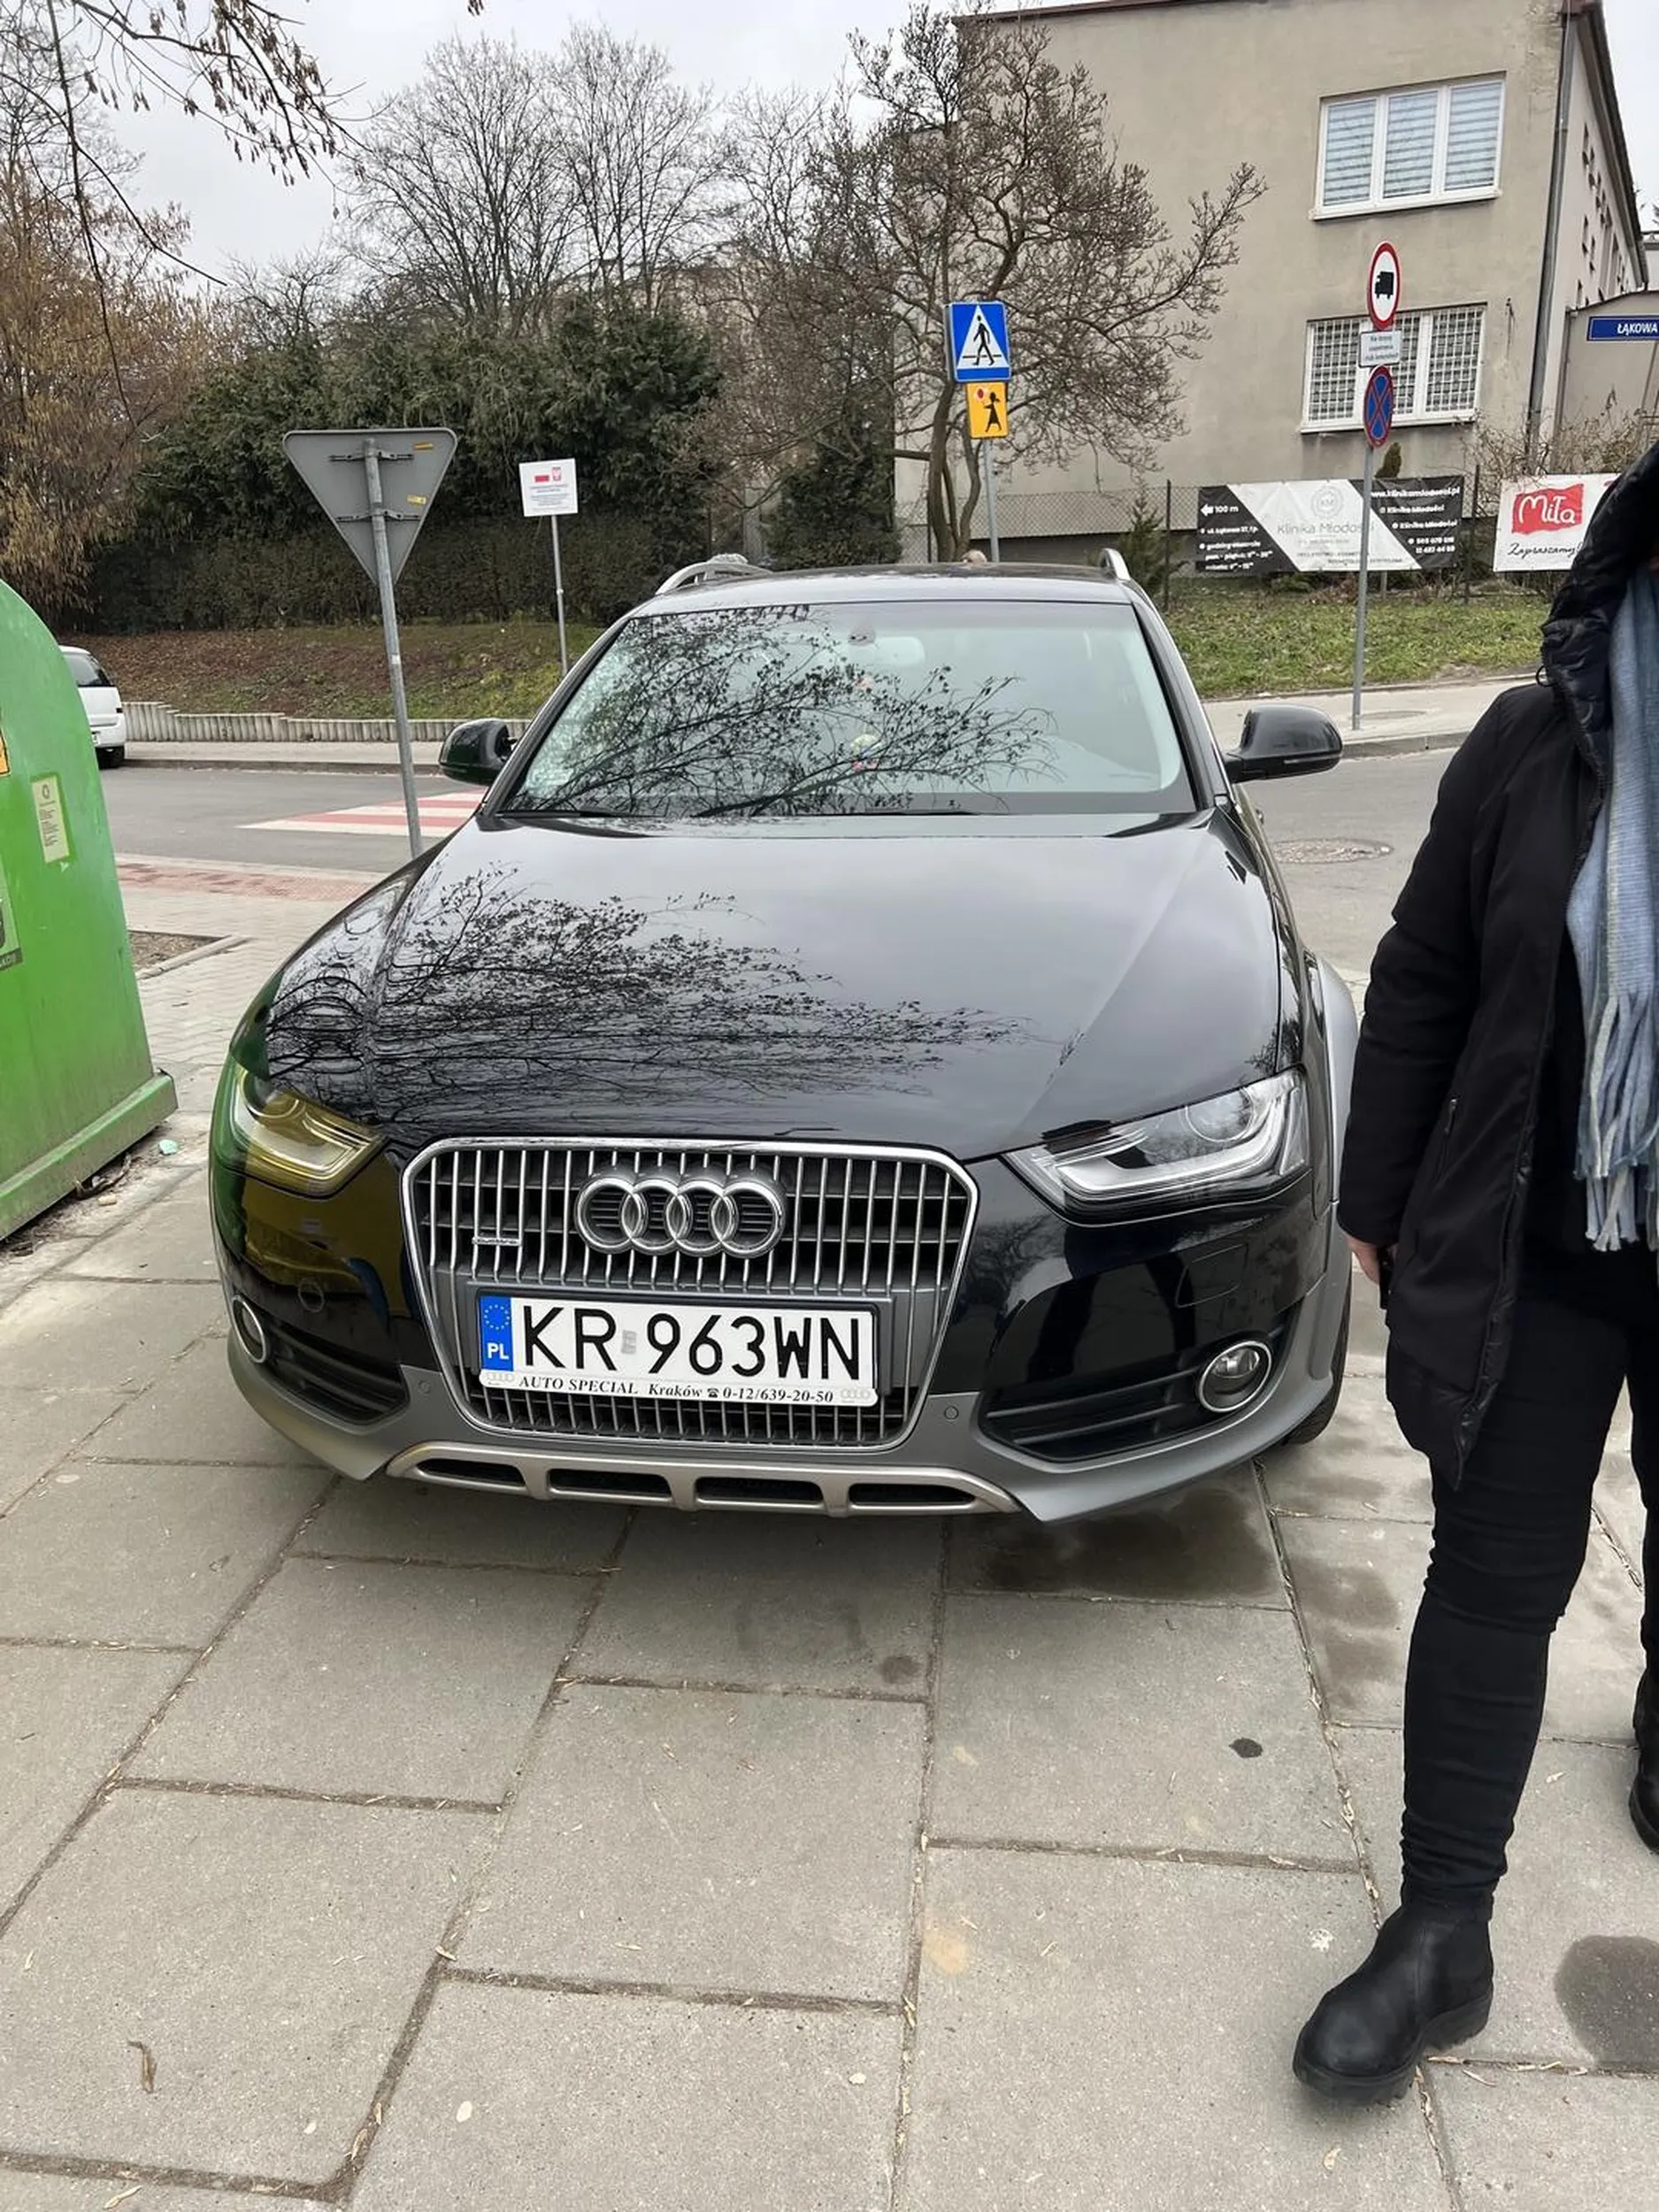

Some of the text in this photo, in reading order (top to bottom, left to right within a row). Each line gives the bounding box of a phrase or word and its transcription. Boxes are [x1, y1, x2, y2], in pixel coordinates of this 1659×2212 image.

[1617, 322, 1658, 336] ŁĄKOWA
[488, 1342, 510, 1360] PL
[524, 1305, 859, 1380] KR 963WN
[518, 1376, 833, 1403] AUTO SPECIAL Kraków 0-12/639-20-50
